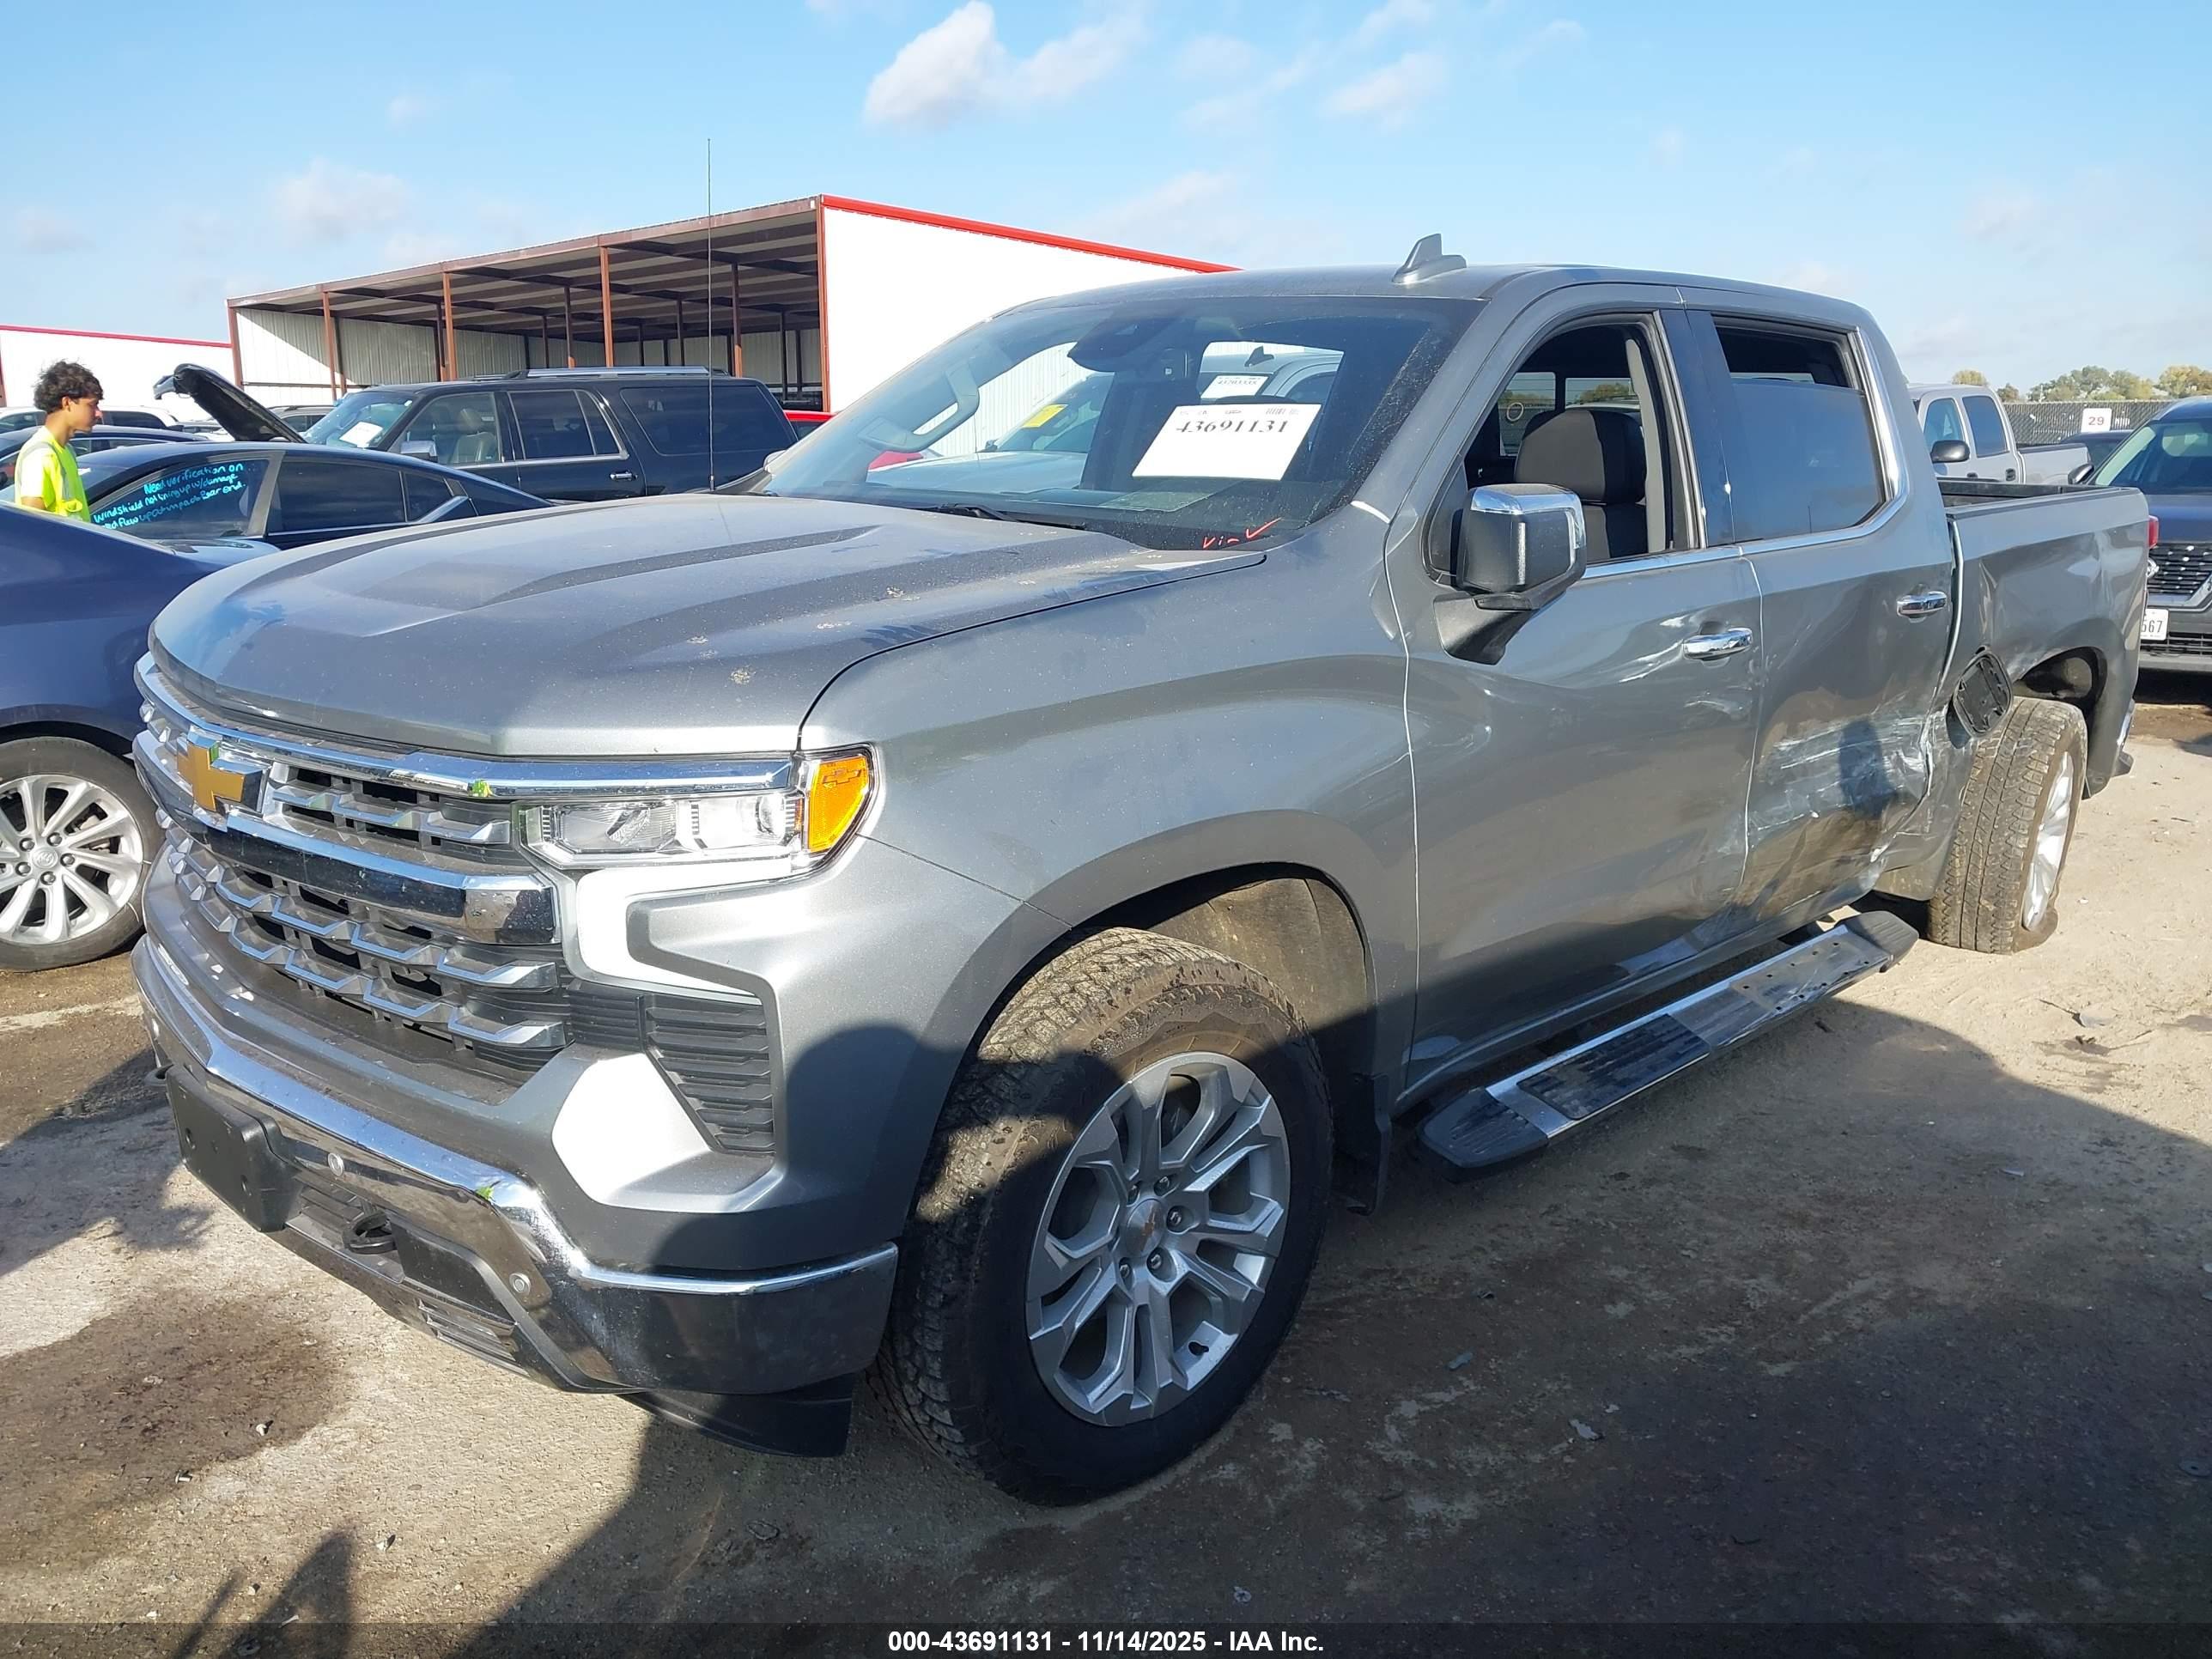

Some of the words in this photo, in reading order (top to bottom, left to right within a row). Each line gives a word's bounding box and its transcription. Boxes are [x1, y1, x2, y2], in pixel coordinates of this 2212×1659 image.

[1176, 419, 1288, 433] 43691131
[2087, 416, 2105, 426] 29
[228, 464, 244, 472] on
